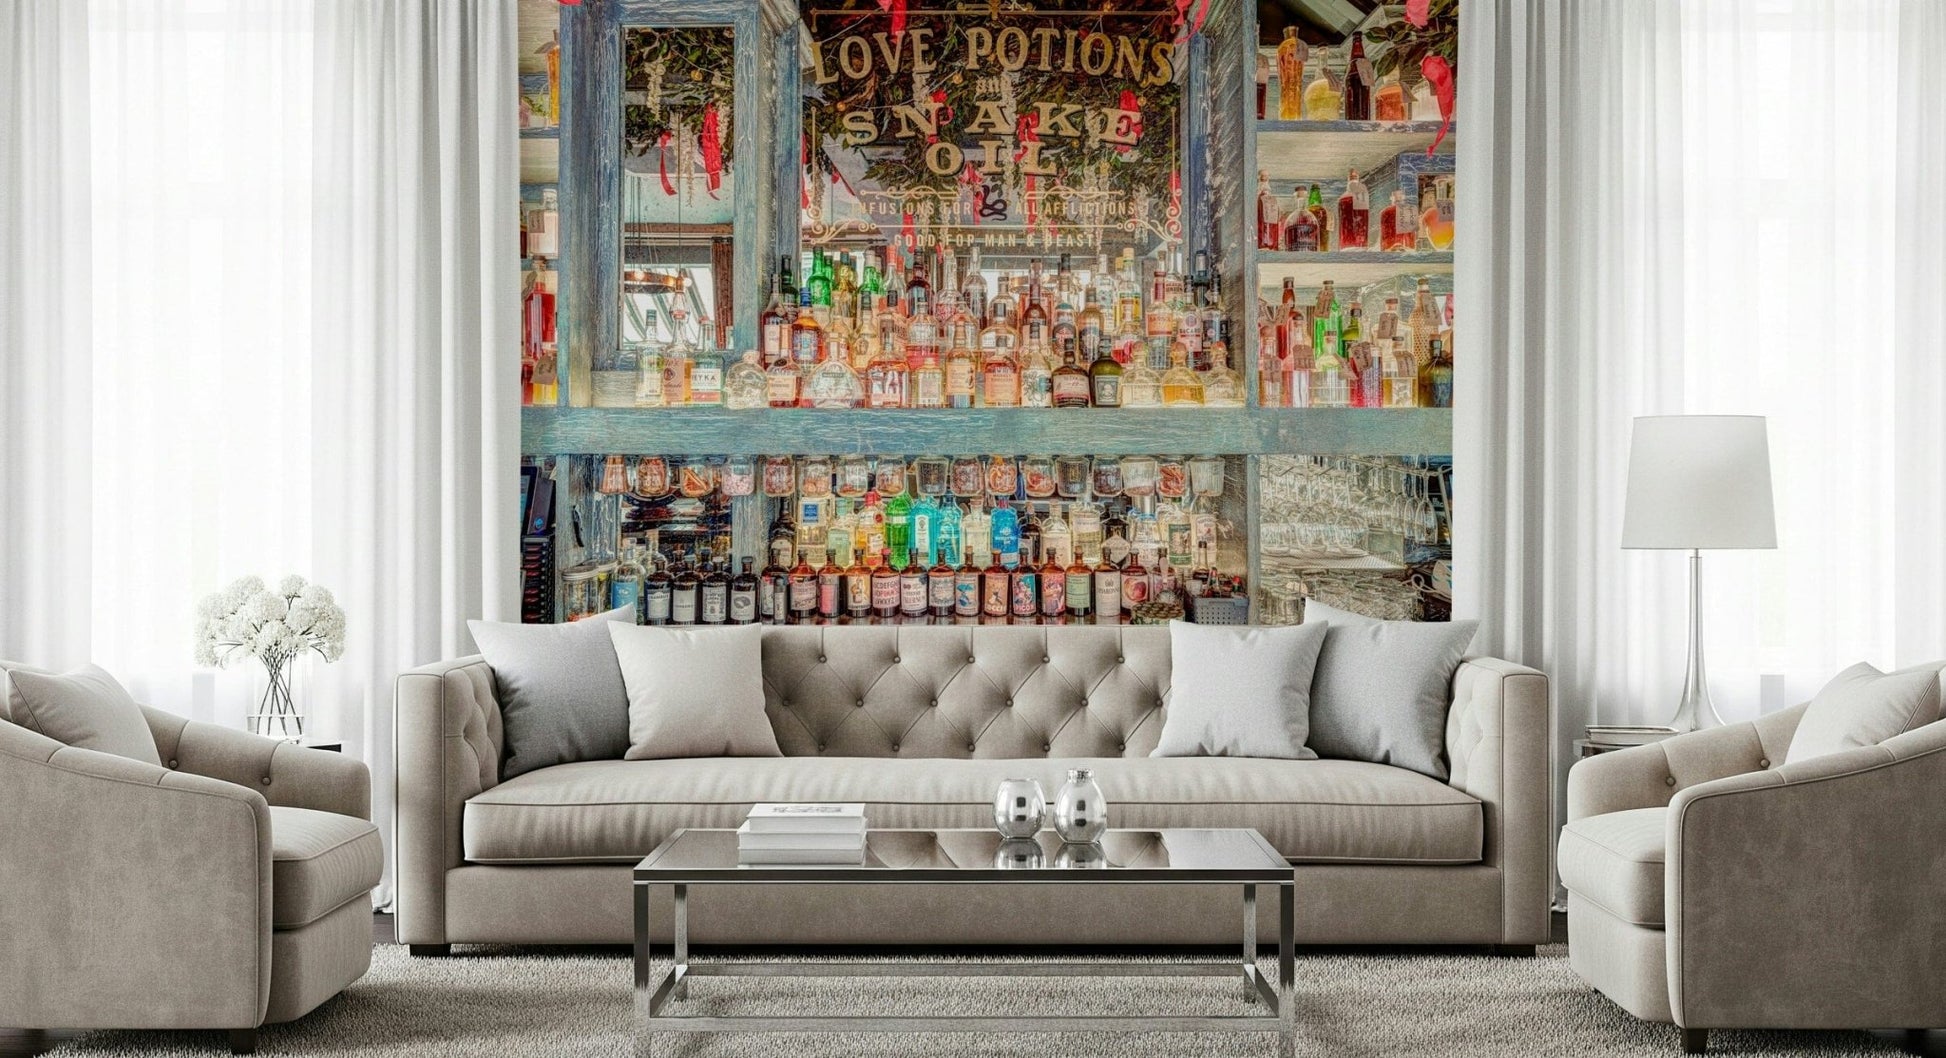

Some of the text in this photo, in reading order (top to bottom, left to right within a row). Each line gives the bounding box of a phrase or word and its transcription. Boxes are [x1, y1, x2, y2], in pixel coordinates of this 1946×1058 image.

[808, 26, 1175, 88] LOVE POTIONS
[842, 101, 1142, 146] SNAKE
[925, 140, 1058, 176] OIL
[851, 202, 1135, 215] INFUSIONS FOR ALL AFFLICTIONS
[894, 233, 936, 247] GOOD
[984, 233, 1016, 247] MAN
[1026, 233, 1035, 247] &
